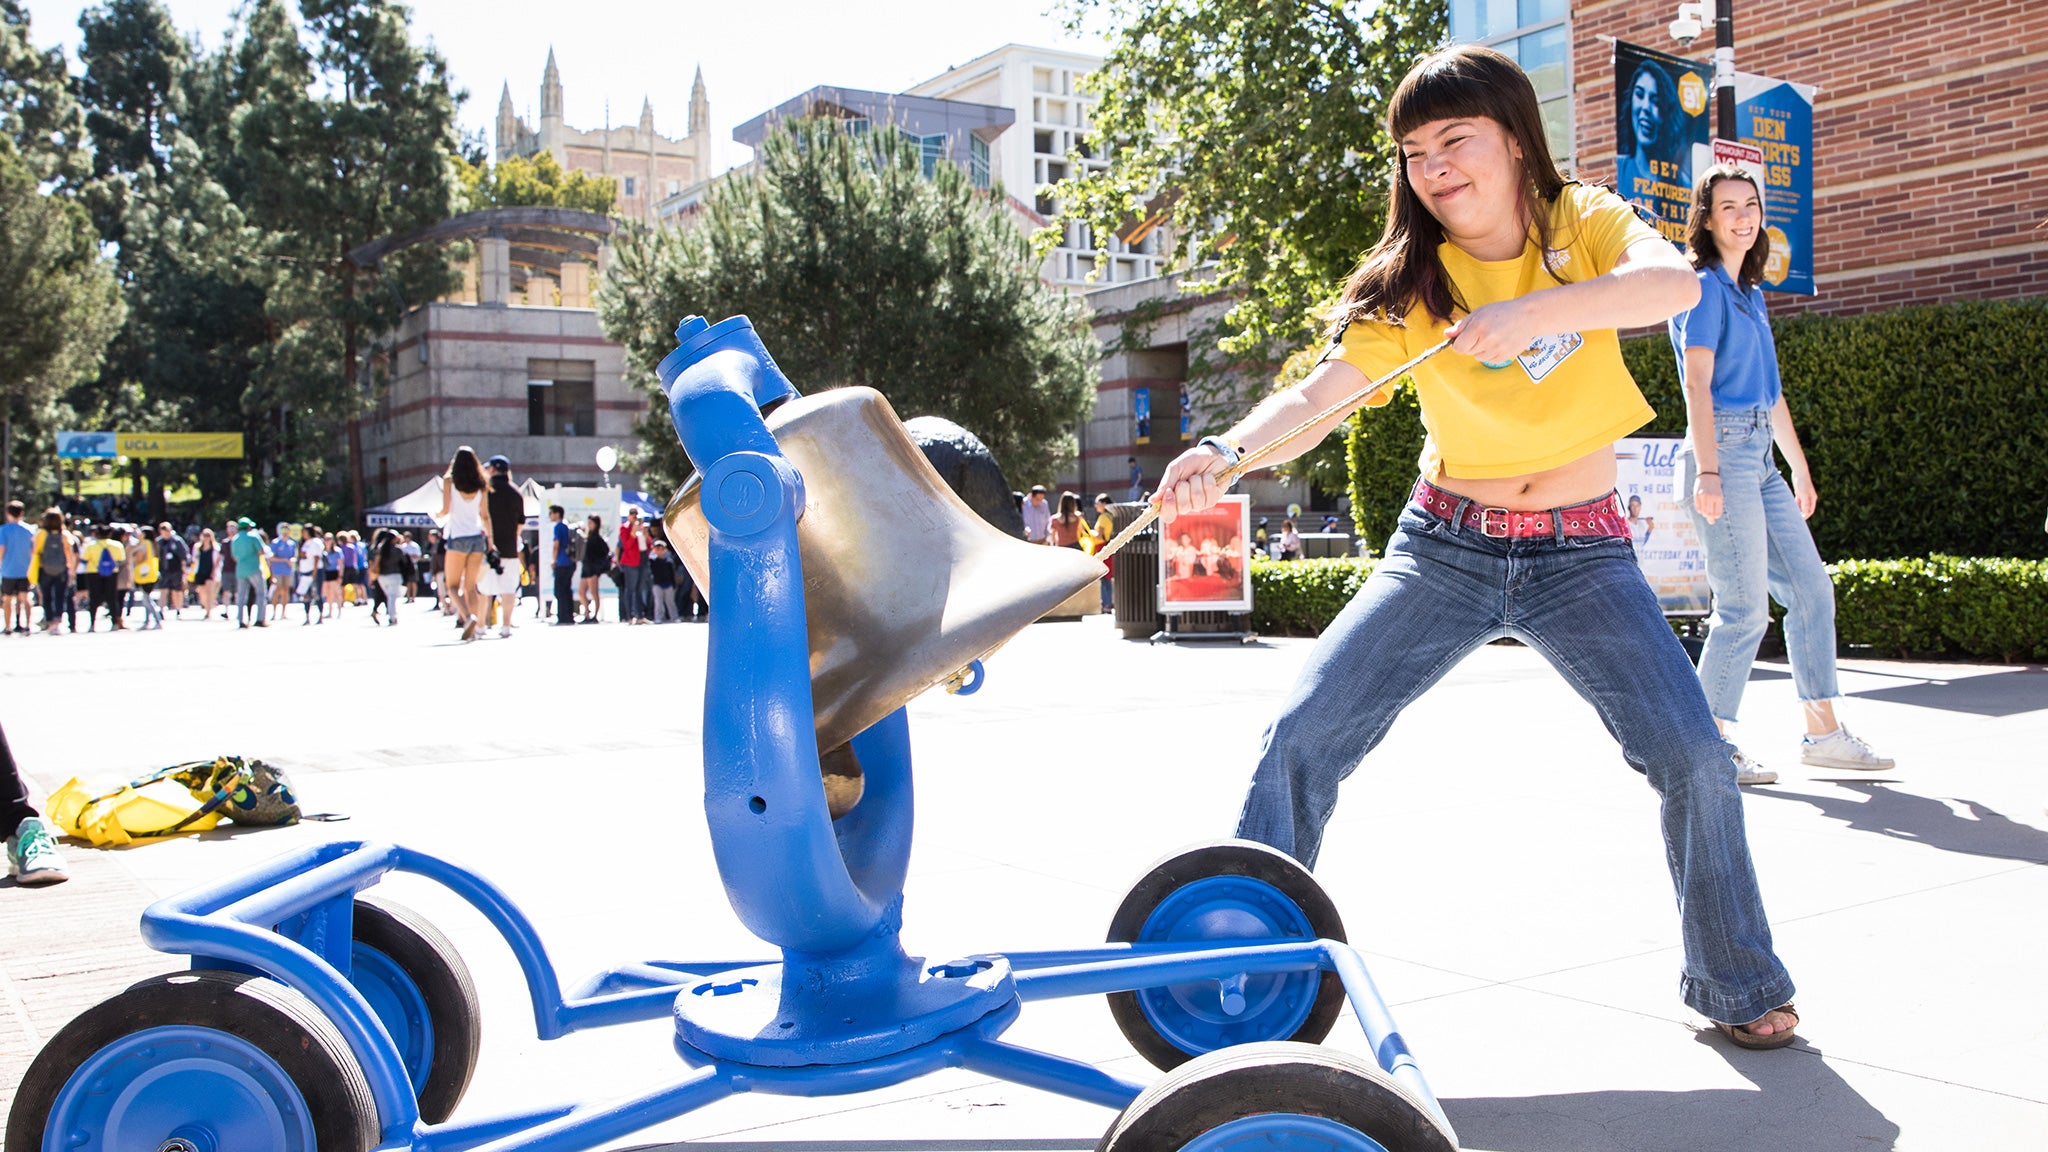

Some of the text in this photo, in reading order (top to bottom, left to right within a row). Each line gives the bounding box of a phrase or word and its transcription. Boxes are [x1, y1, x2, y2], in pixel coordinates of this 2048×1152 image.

[1753, 115, 1786, 140] DEN
[1738, 137, 1800, 167] ORTS
[1650, 160, 1679, 179] GET
[1764, 164, 1792, 187] ASS
[124, 440, 159, 450] UCLA
[1642, 443, 1679, 467] Ucl
